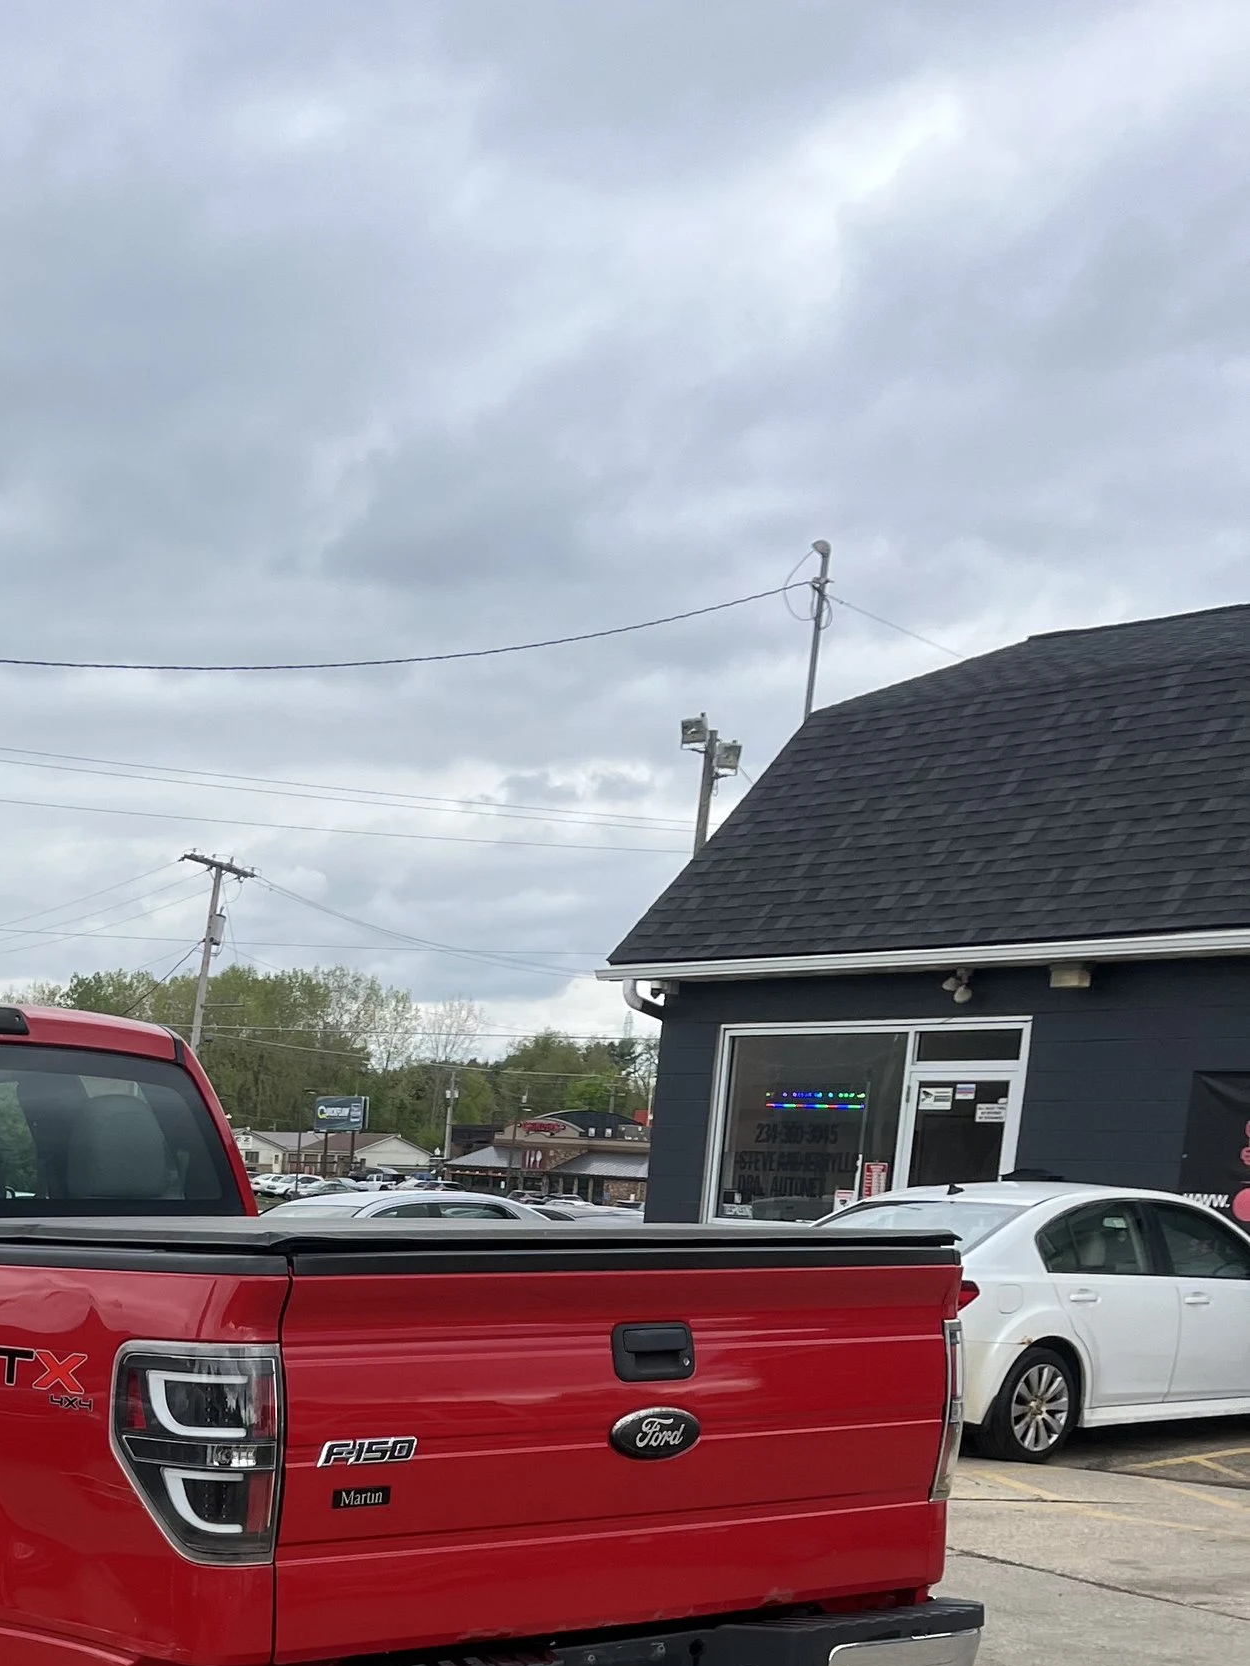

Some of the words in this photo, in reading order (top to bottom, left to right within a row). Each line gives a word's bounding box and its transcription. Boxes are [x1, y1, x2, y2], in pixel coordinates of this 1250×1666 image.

[635, 1417, 685, 1447] Ford
[316, 1436, 417, 1468] F-150
[340, 1489, 383, 1507] Martin
